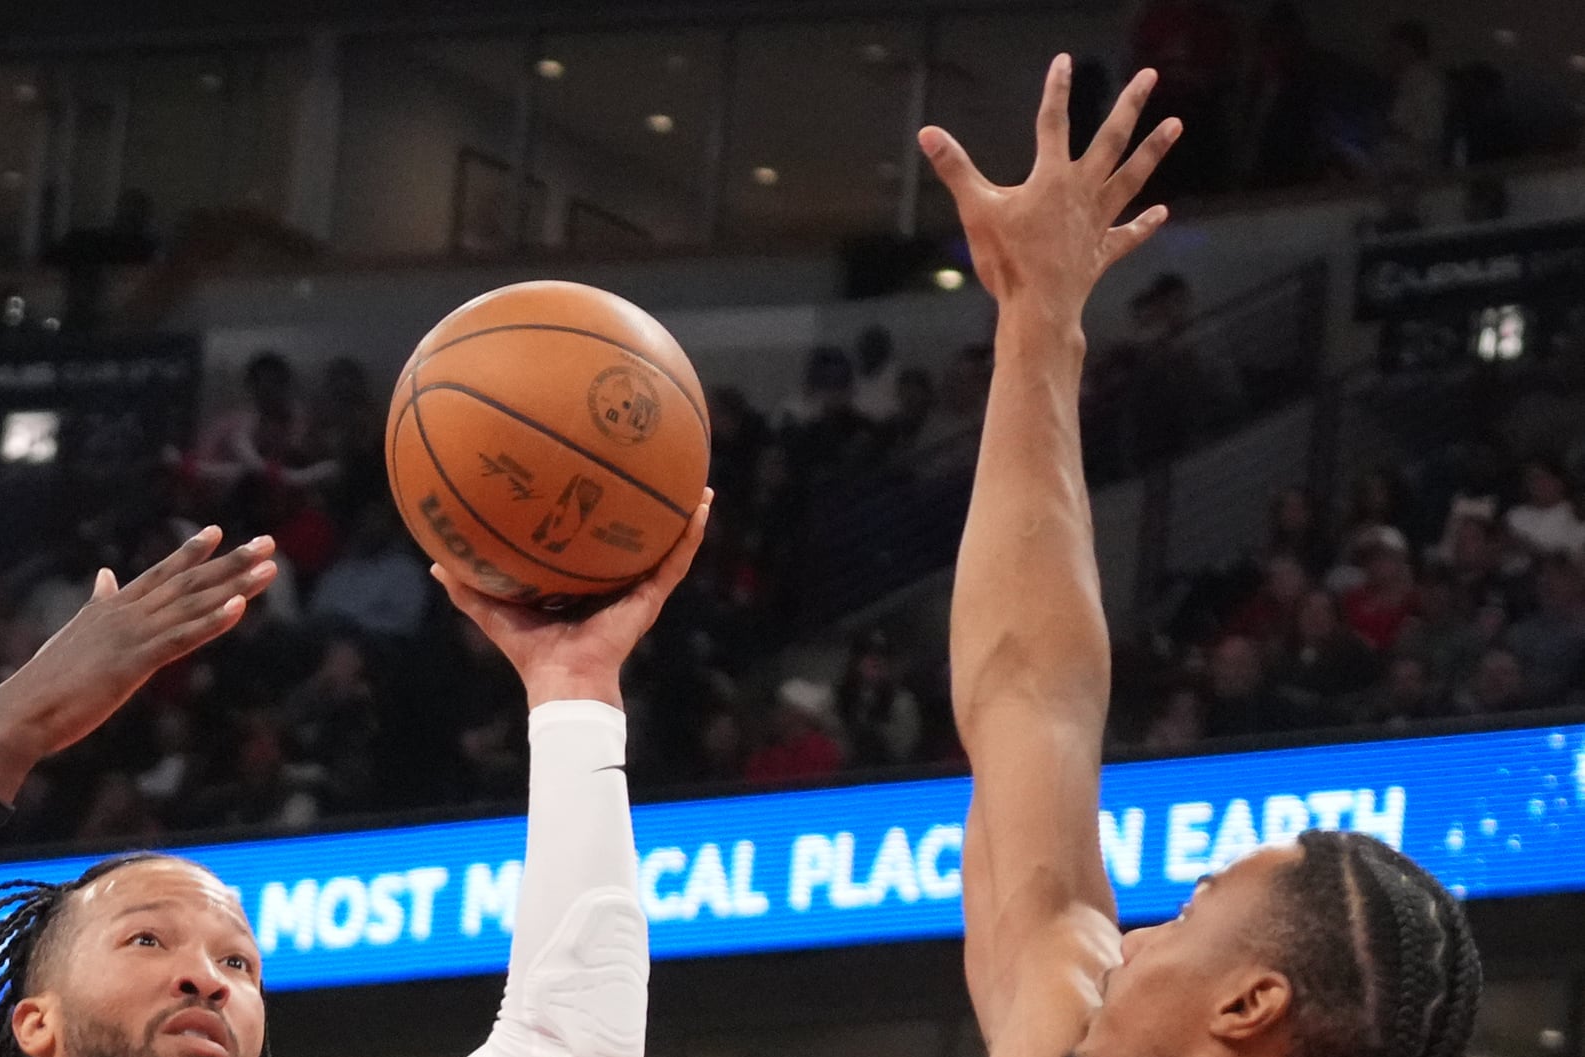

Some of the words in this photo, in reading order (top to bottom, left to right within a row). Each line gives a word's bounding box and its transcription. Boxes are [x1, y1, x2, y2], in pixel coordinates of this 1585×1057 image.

[258, 866, 448, 952] MOST
[461, 840, 769, 936] MCAL
[788, 824, 965, 912] PLAC
